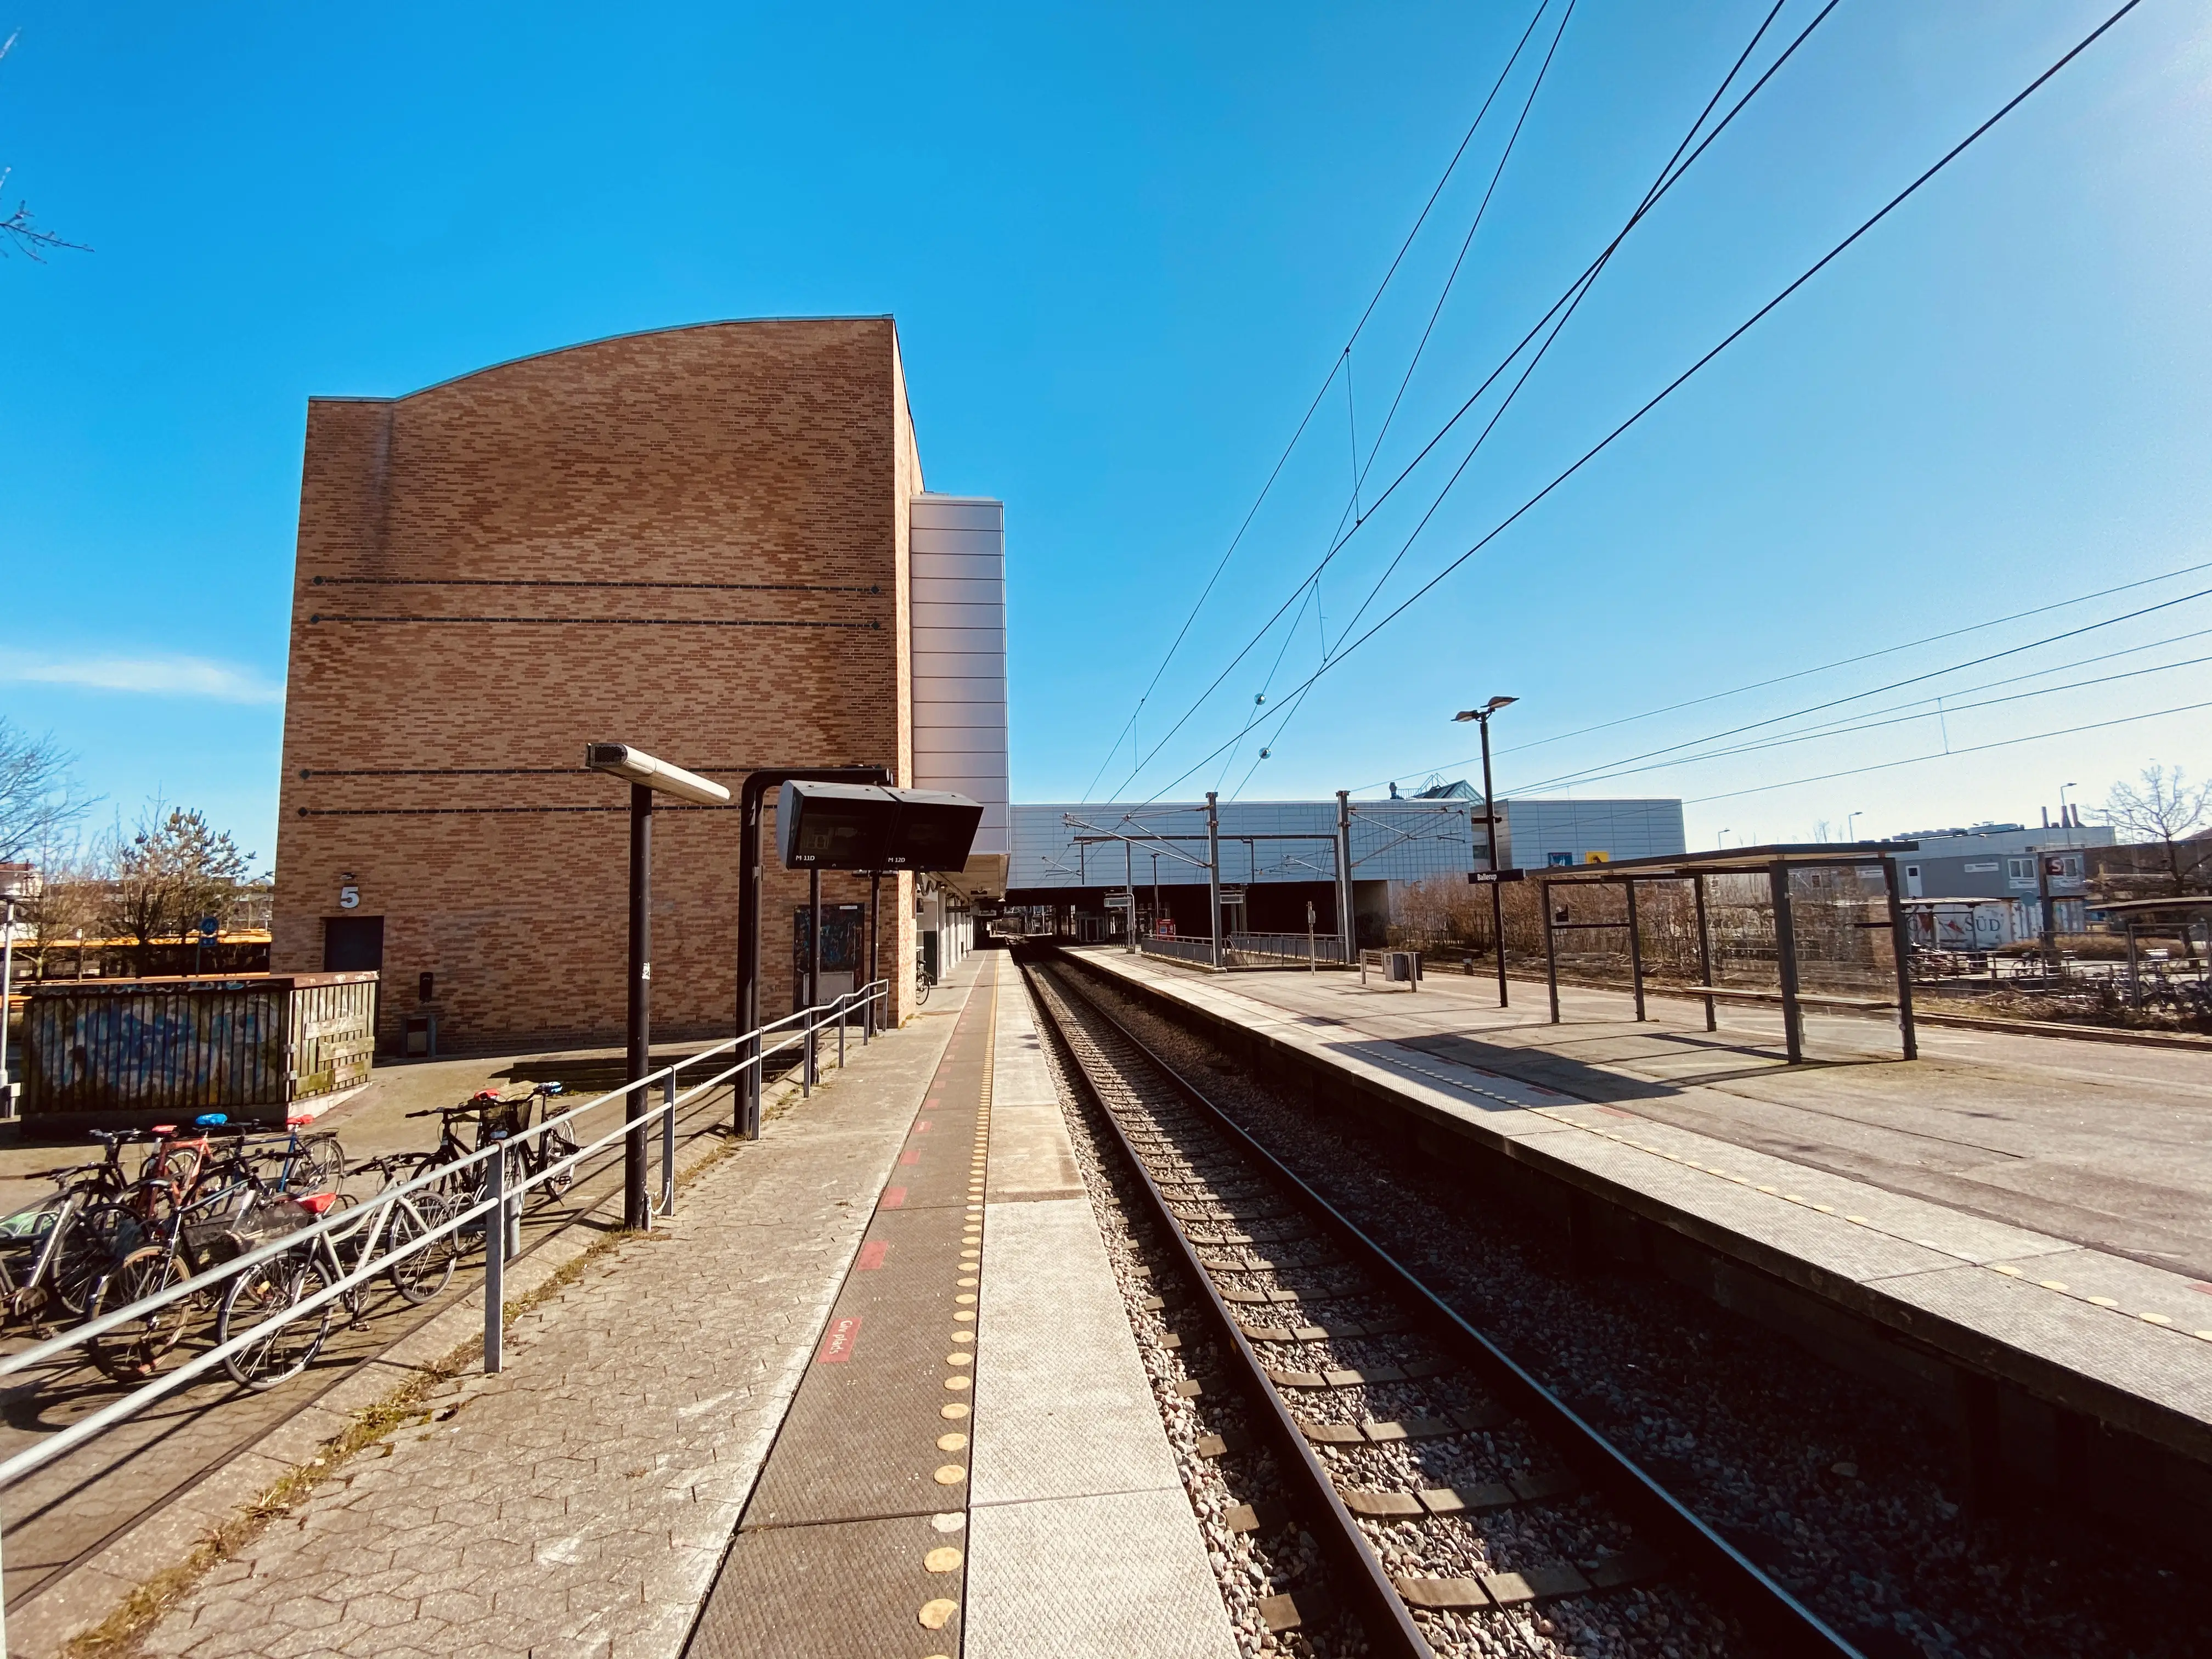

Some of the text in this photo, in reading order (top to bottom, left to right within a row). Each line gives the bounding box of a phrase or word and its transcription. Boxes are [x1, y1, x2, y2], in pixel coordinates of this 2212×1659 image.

[2051, 859, 2062, 872] S
[1477, 873, 1497, 882] Ballerup
[340, 887, 359, 909] 5
[1965, 915, 2001, 932] SÜD
[829, 1320, 853, 1355] Giv plads
